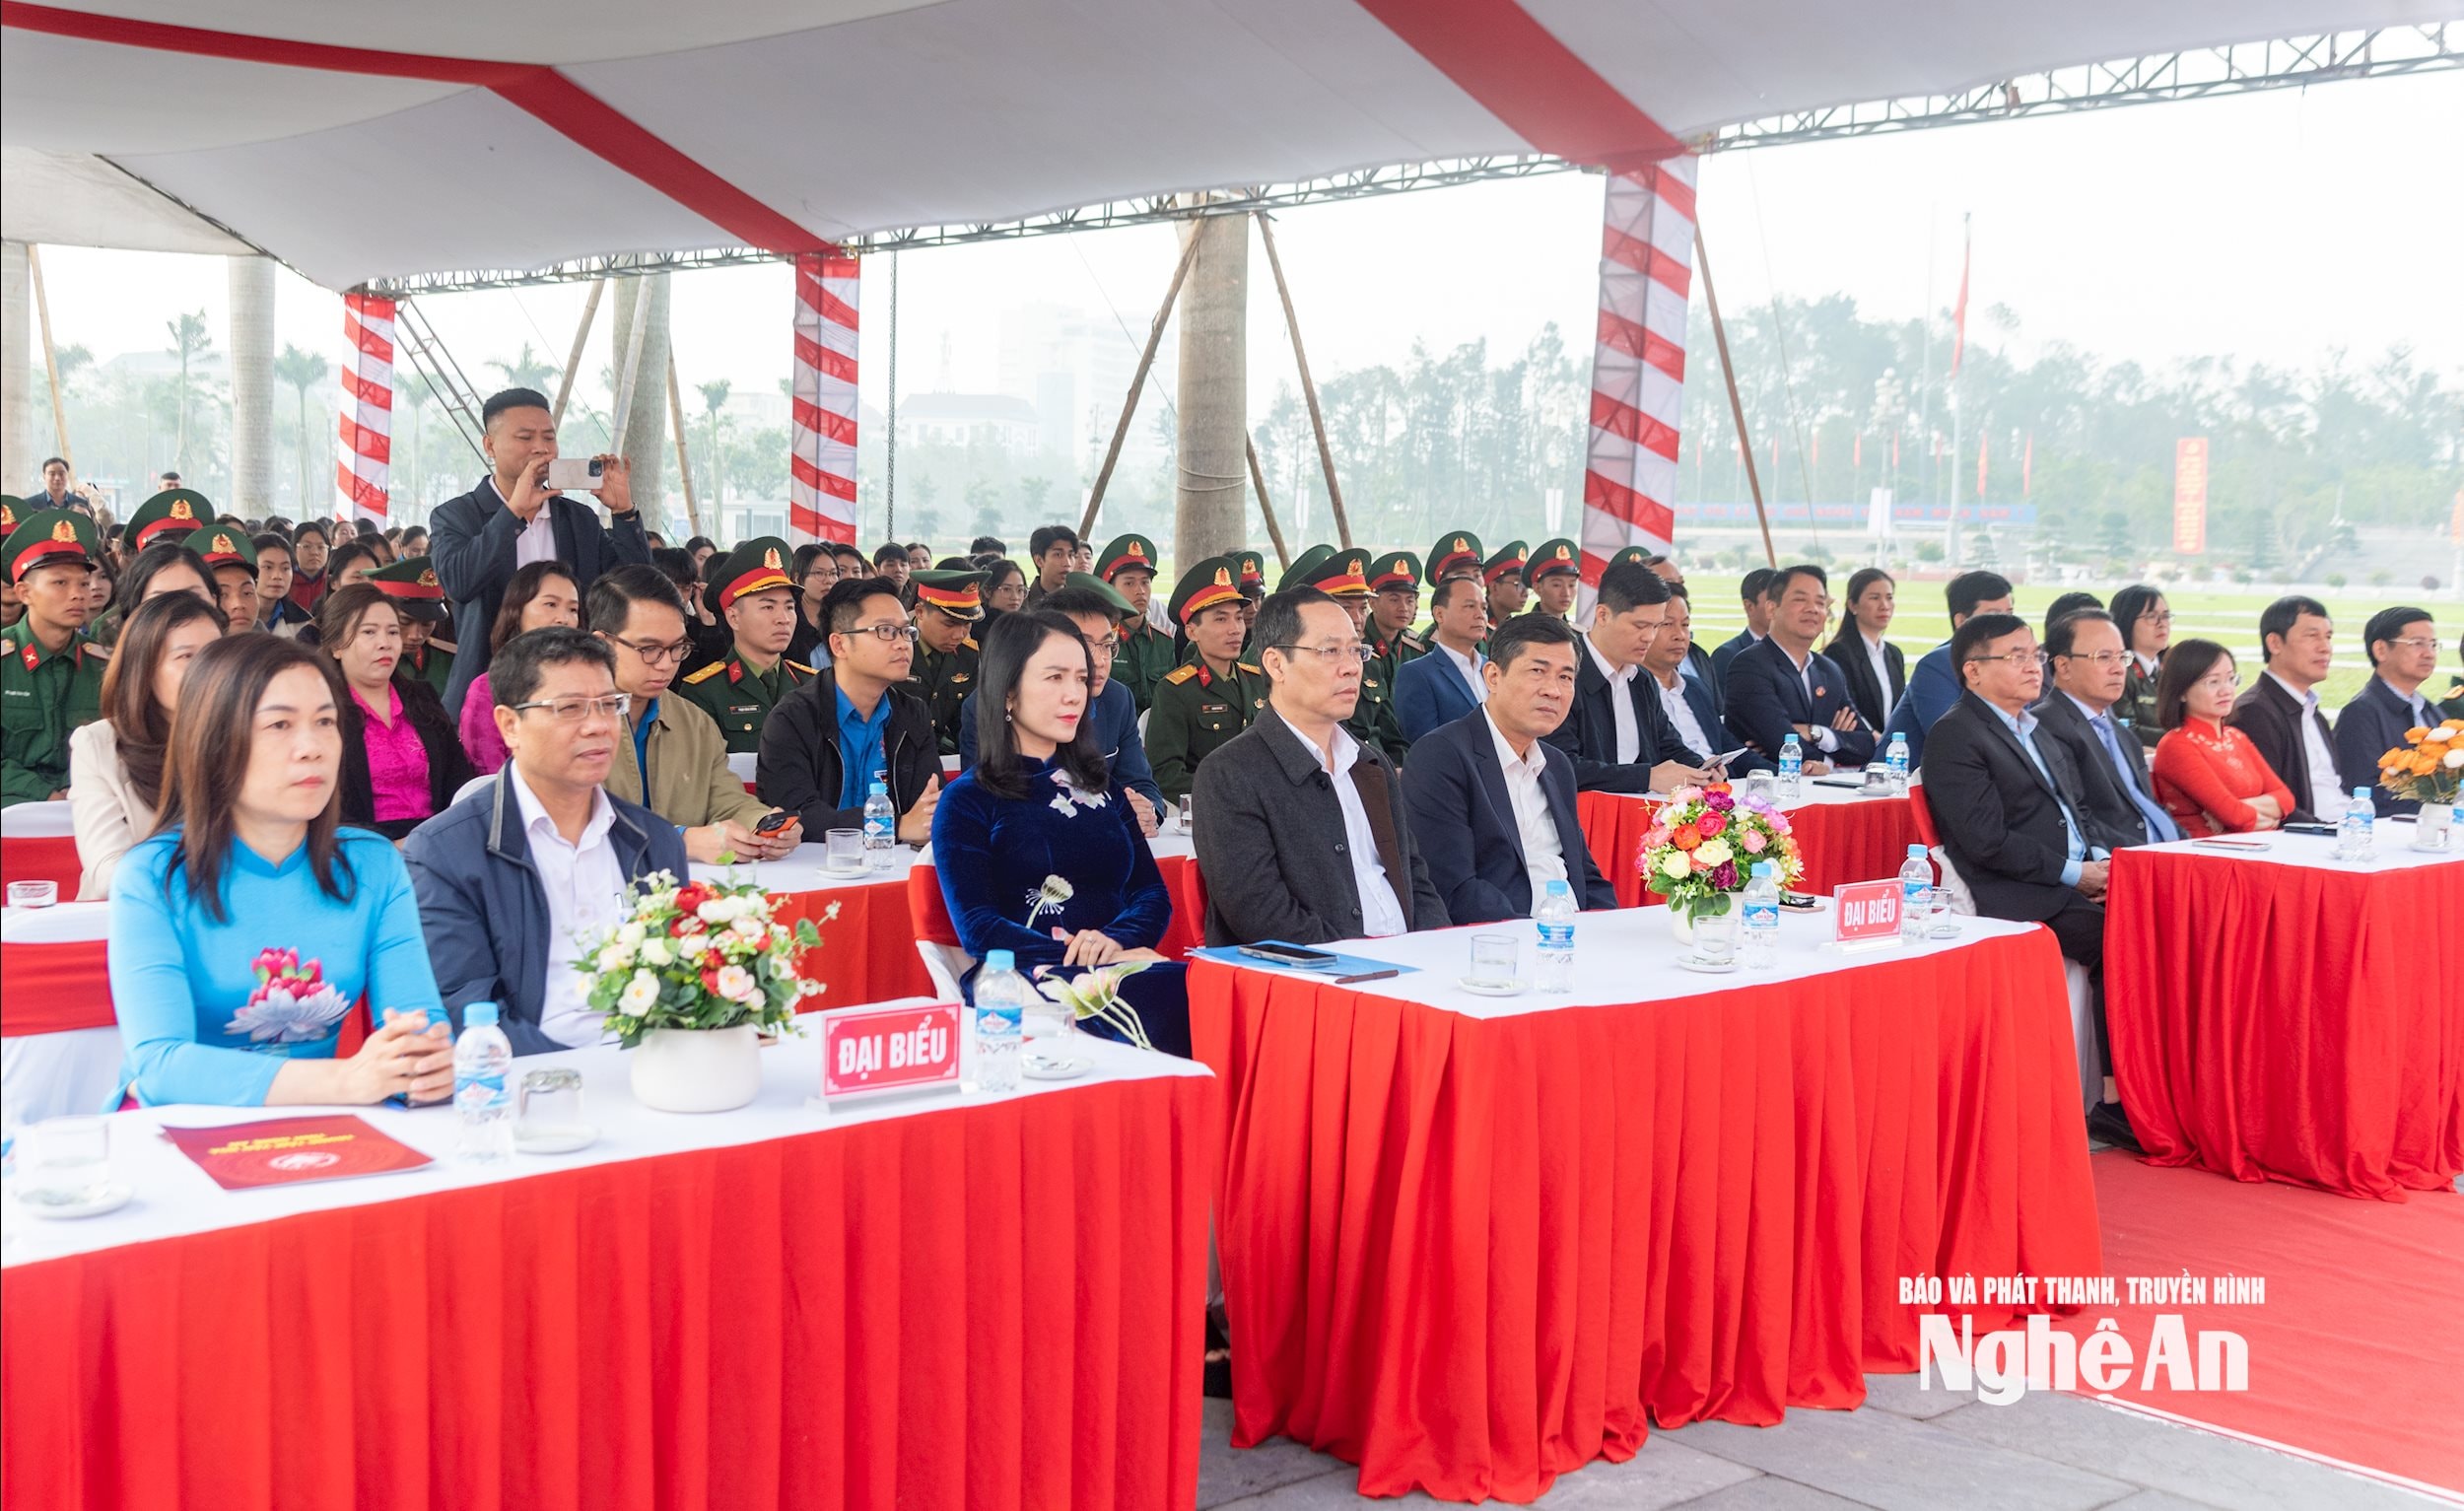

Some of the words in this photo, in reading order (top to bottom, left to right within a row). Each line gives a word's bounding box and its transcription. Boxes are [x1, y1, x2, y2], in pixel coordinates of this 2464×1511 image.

[1844, 900, 1866, 931] ĐẠI
[1868, 888, 1896, 925] BIỂU
[838, 1034, 883, 1080] ĐẠI
[889, 1014, 947, 1069] BIỂU
